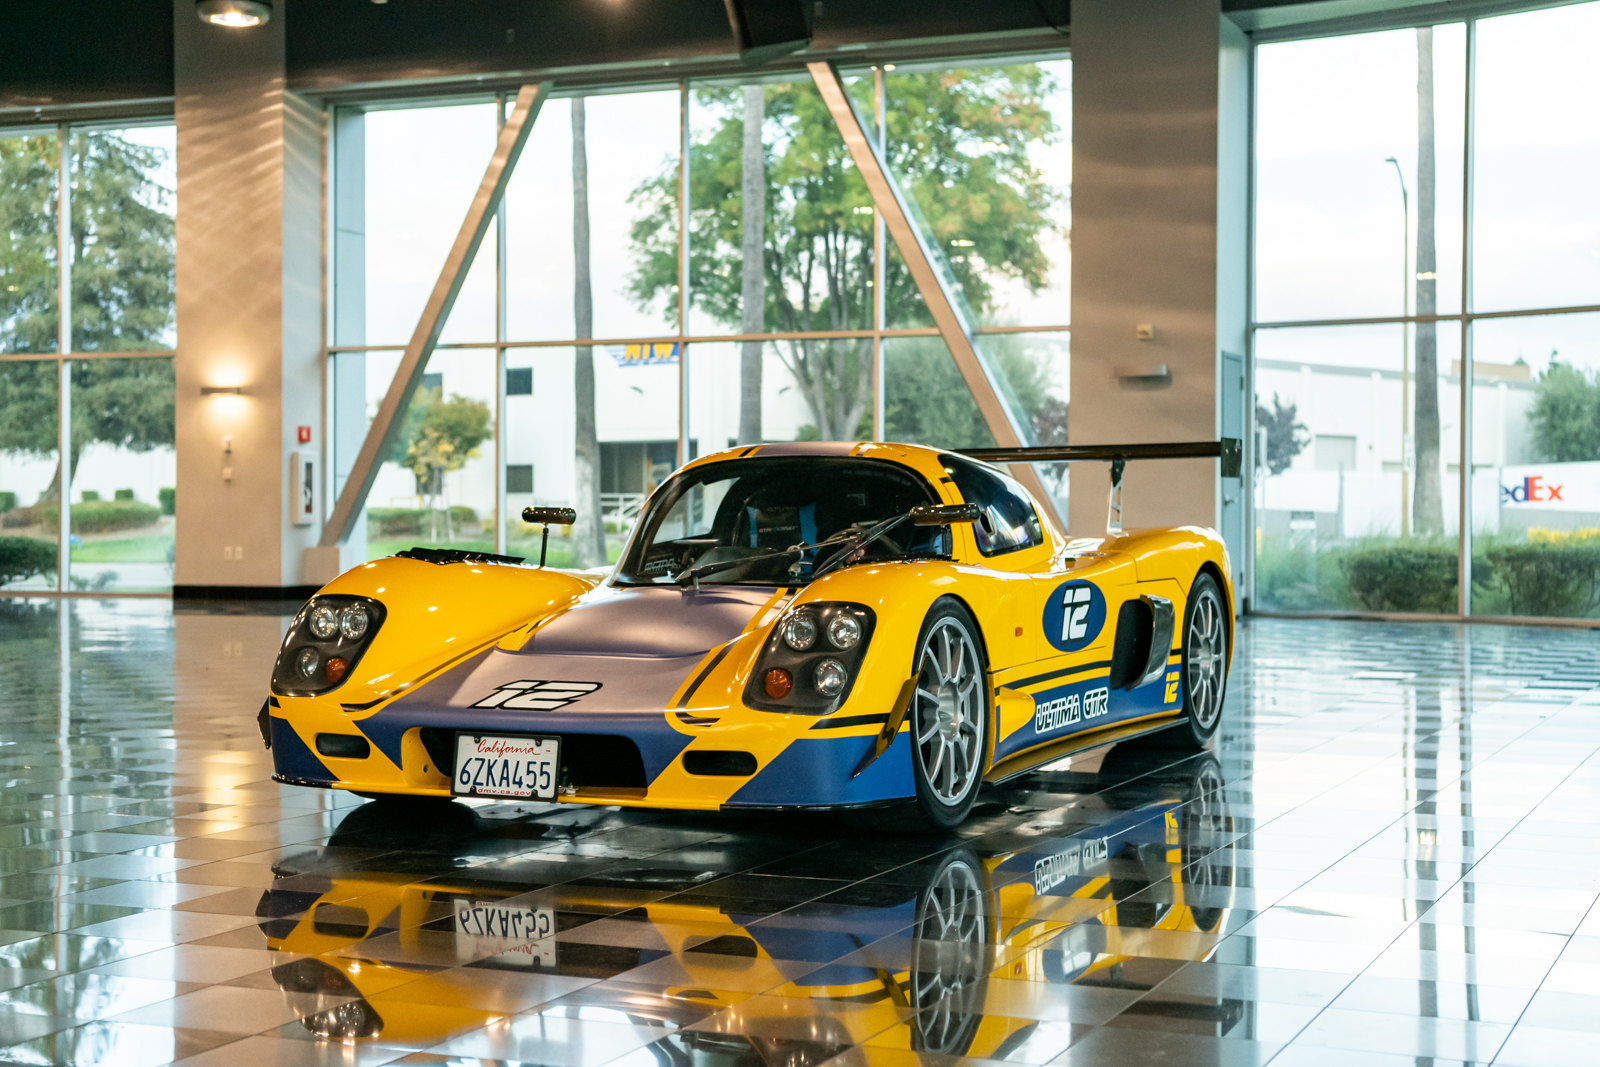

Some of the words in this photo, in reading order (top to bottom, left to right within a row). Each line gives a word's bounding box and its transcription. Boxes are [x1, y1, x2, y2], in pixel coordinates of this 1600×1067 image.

[1060, 584, 1092, 645] 12
[466, 680, 603, 711] 12
[1164, 671, 1180, 704] 12
[1035, 694, 1081, 734] ULTIMA
[1083, 687, 1109, 719] GTR
[477, 739, 541, 758] California
[459, 757, 551, 790] 6ZKA455
[477, 787, 532, 796] dmv.ca.gov
